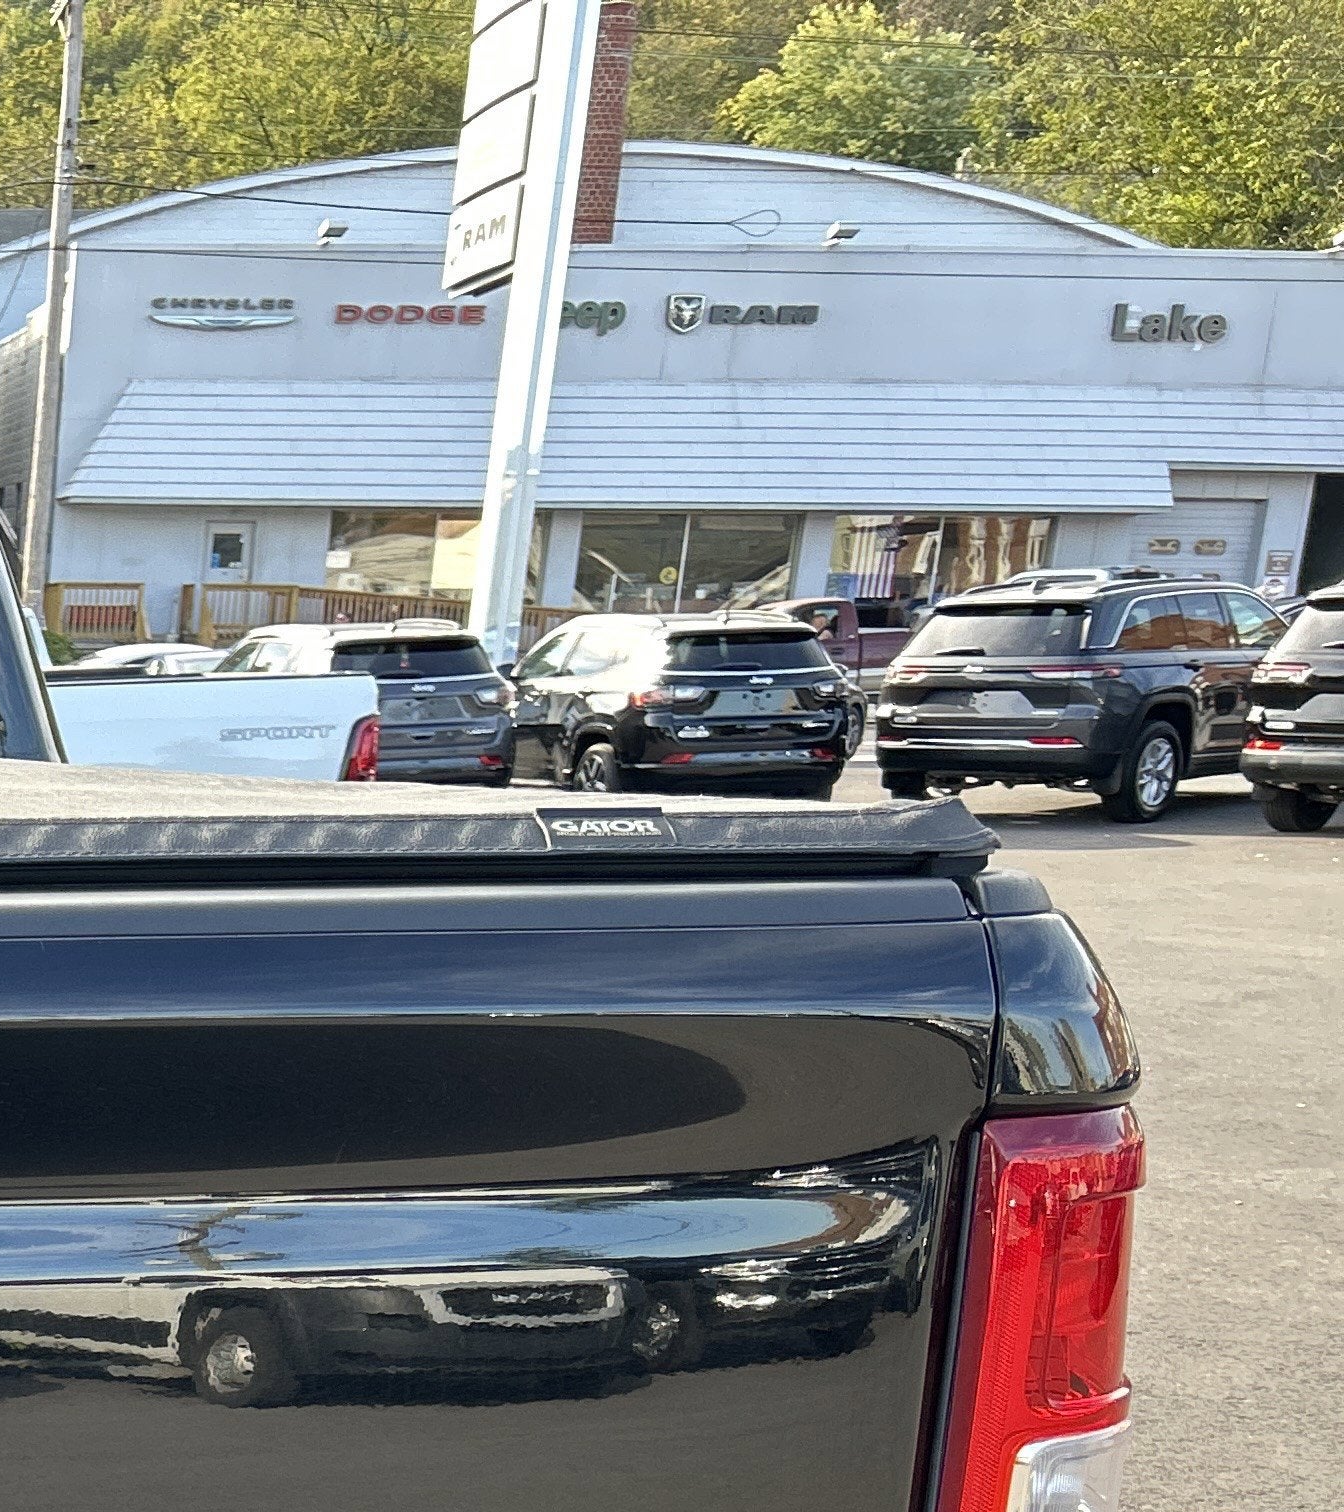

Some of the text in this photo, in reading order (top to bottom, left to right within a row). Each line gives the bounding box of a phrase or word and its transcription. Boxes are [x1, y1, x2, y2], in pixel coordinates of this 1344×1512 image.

[462, 214, 507, 252] RAM
[150, 297, 295, 311] CHRYSLER
[709, 304, 820, 325] RAM
[334, 304, 487, 326] DODGE
[561, 300, 627, 337] eep
[1111, 303, 1228, 343] Lake
[219, 724, 336, 741] SPORT
[551, 820, 661, 833] GATOR
